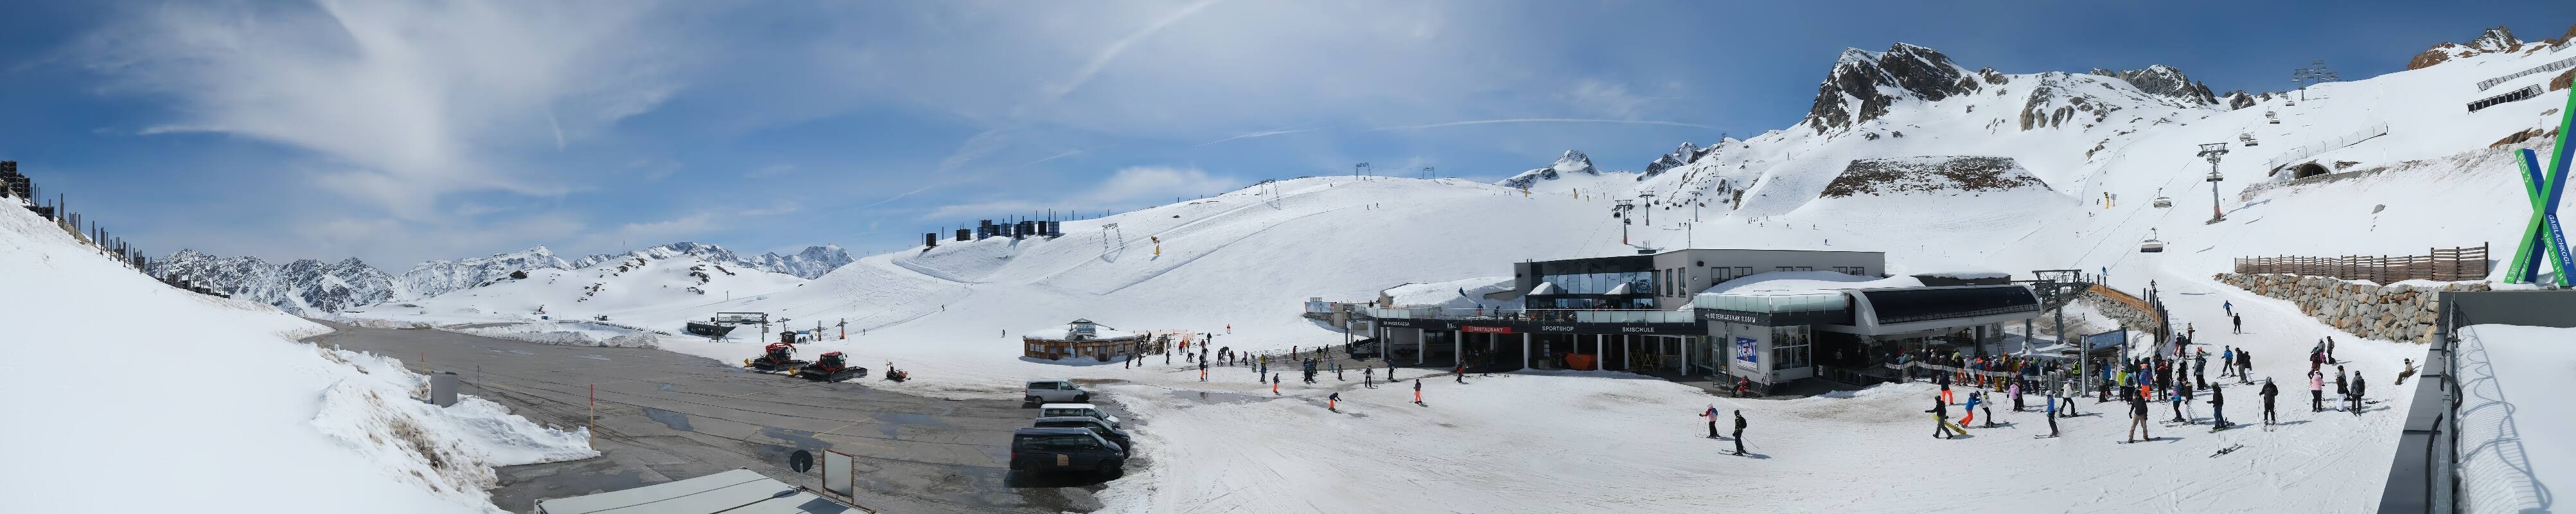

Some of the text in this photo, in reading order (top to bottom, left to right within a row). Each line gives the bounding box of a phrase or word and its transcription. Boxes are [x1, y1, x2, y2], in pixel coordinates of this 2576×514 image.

[2518, 152, 2530, 182] BIG 3
[2548, 214, 2570, 266] GAISLACHKOGL
